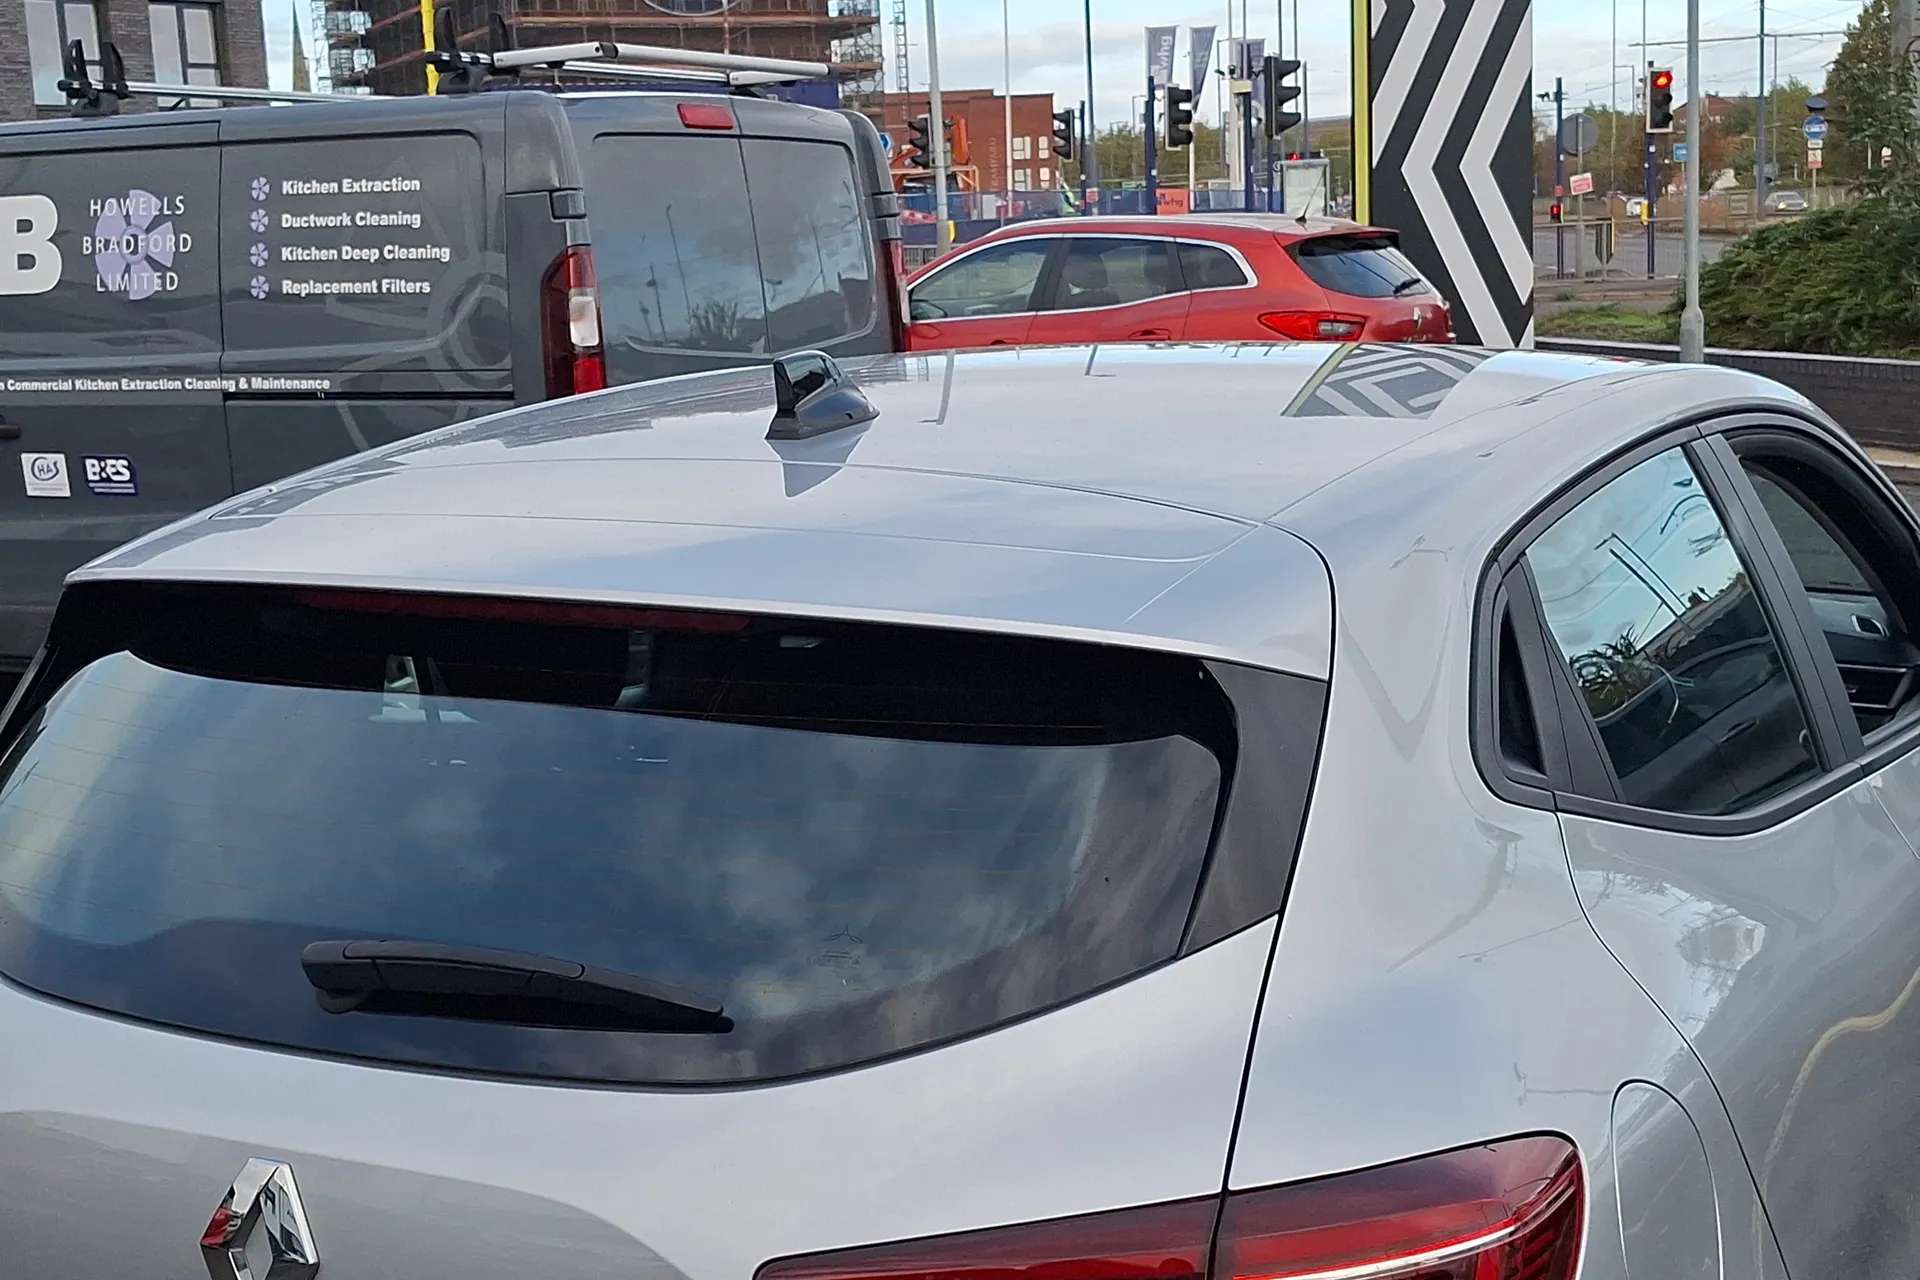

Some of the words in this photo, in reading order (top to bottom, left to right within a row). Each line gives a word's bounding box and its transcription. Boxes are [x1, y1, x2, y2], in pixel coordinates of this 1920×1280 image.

[282, 180, 339, 195] Kitchen
[342, 177, 421, 193] Extraction
[90, 195, 185, 217] HOWELLS
[281, 212, 352, 228] Ductwork
[355, 211, 421, 229] Cleaning
[0, 194, 62, 295] B
[82, 233, 192, 255] BRADFORD
[281, 246, 338, 261] Kitchen
[341, 245, 380, 263] Deep
[383, 244, 450, 262] Cleaning
[96, 271, 179, 292] LIMITED
[282, 279, 378, 297] Replacement
[381, 278, 431, 294] Filters
[7, 379, 72, 391] Commercial
[74, 378, 119, 391] Kitchen
[121, 377, 182, 390] Extraction
[184, 377, 236, 392] Cleaning
[239, 378, 249, 390] &
[251, 376, 331, 390] Maintenance
